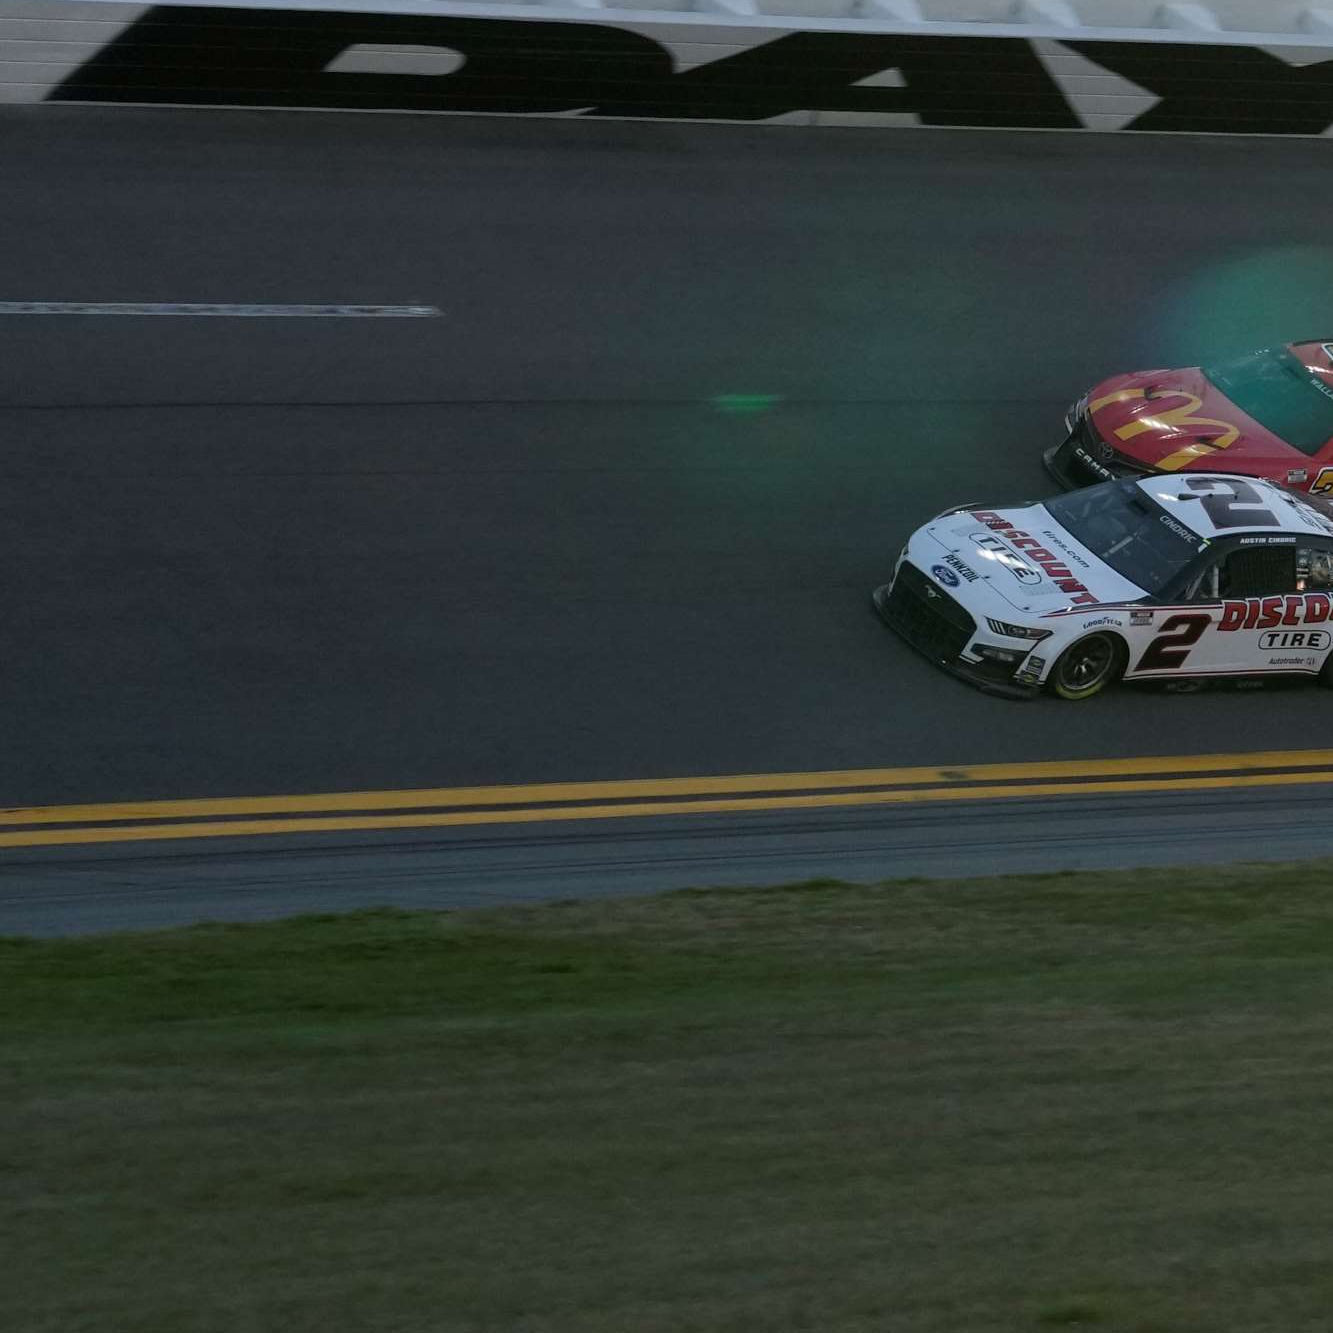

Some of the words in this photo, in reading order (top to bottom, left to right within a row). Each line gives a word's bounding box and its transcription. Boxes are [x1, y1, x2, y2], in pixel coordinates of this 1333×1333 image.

[1185, 477, 1281, 530] 2
[1159, 516, 1197, 543] CINDRIC
[970, 512, 1100, 604] DISCOUNT
[1043, 530, 1090, 568] tires.com
[933, 566, 960, 587] Ford
[942, 554, 980, 583] PENNZOIL
[1133, 614, 1212, 671] 2
[1267, 633, 1322, 647] TIRE
